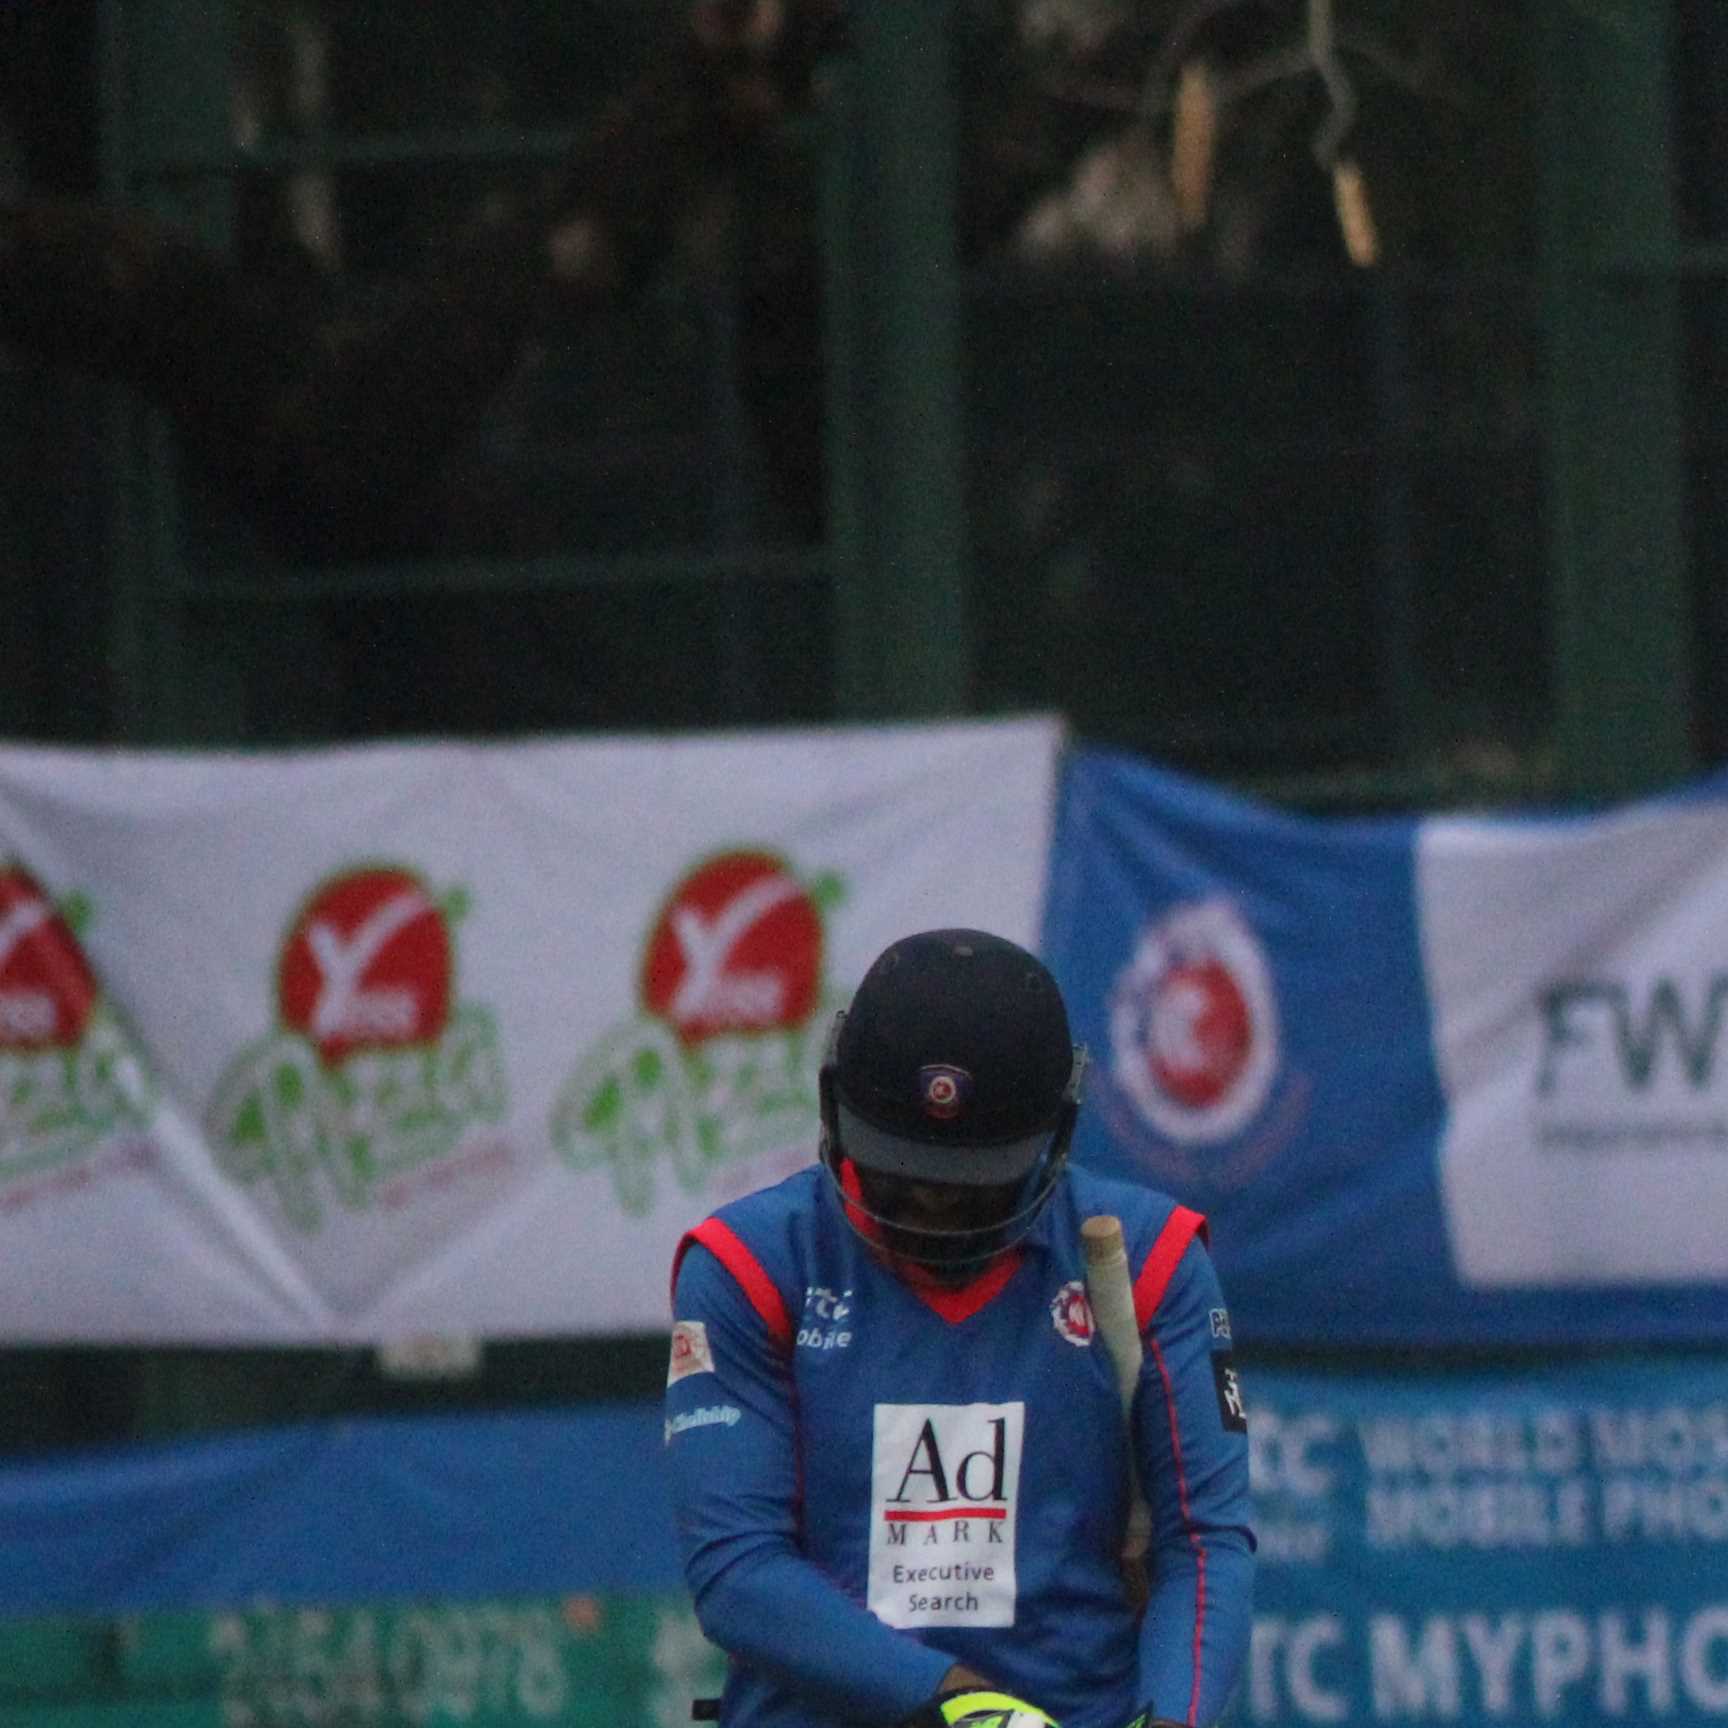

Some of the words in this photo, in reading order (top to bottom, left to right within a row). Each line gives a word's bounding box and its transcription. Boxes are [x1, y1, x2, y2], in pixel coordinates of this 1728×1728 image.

[885, 1417, 1008, 1503] Ad
[886, 1520, 1003, 1546] MARK
[892, 1561, 995, 1584] Executive
[908, 1592, 979, 1613] Search
[1247, 1610, 1345, 1722] TC
